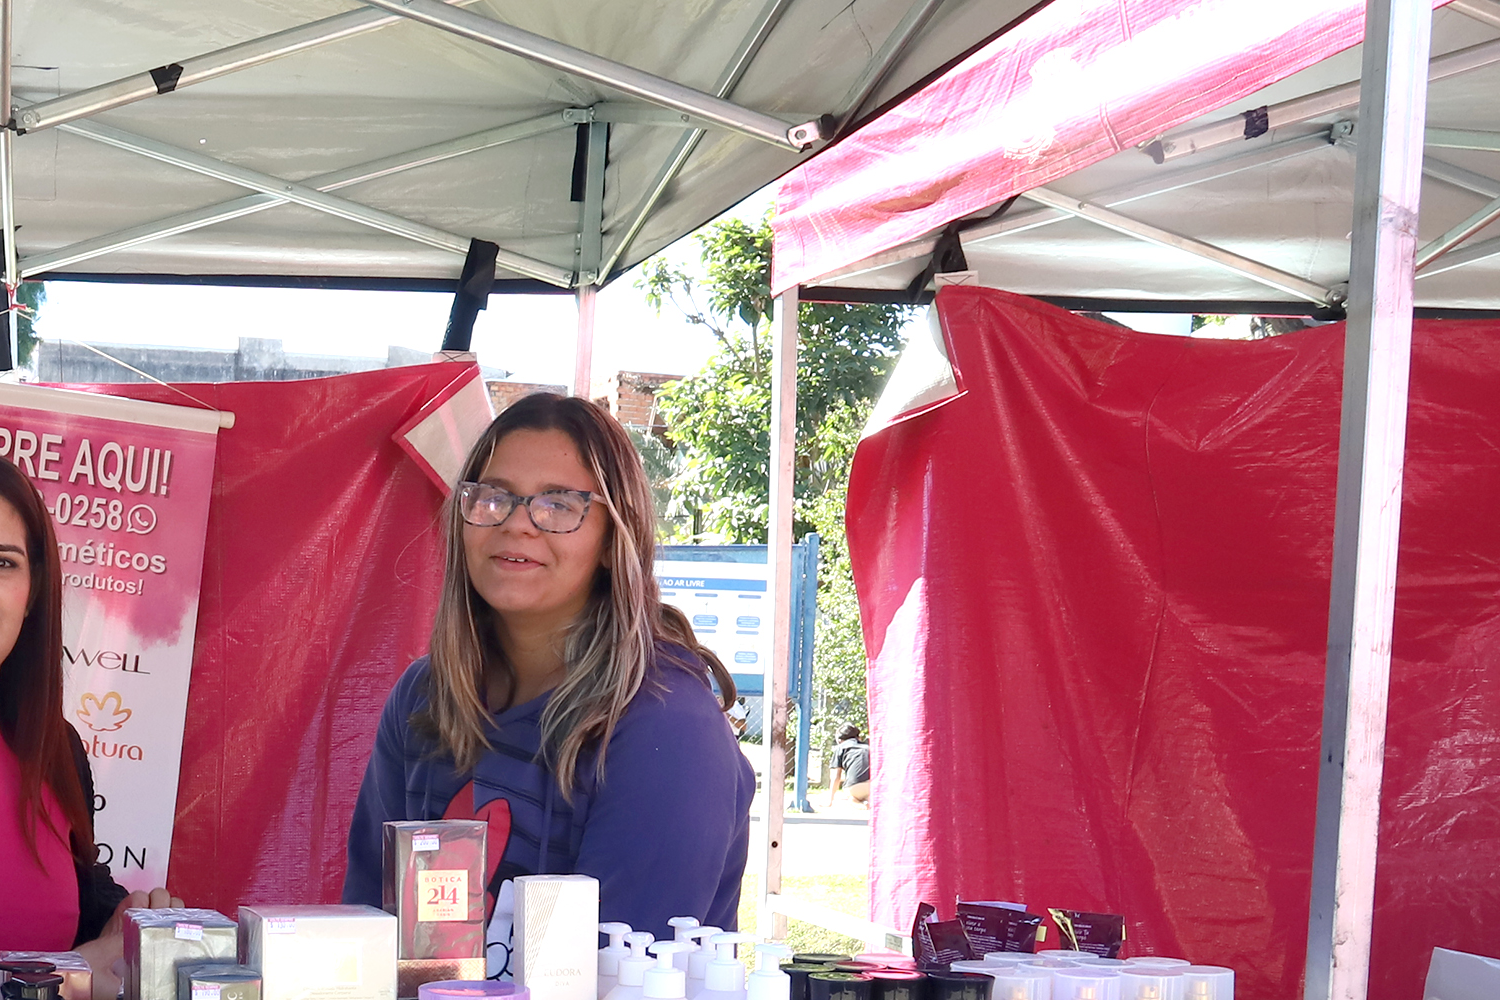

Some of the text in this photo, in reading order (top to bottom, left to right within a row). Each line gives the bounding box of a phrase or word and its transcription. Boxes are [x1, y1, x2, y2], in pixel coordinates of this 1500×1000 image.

[68, 438, 172, 496] AQUI!
[38, 489, 123, 531] -0258
[57, 539, 166, 574] méticos
[62, 572, 144, 595] rodutos!
[685, 580, 705, 588] LIVRE
[81, 735, 143, 761] atura
[95, 843, 147, 870] ON
[427, 885, 460, 905] 214
